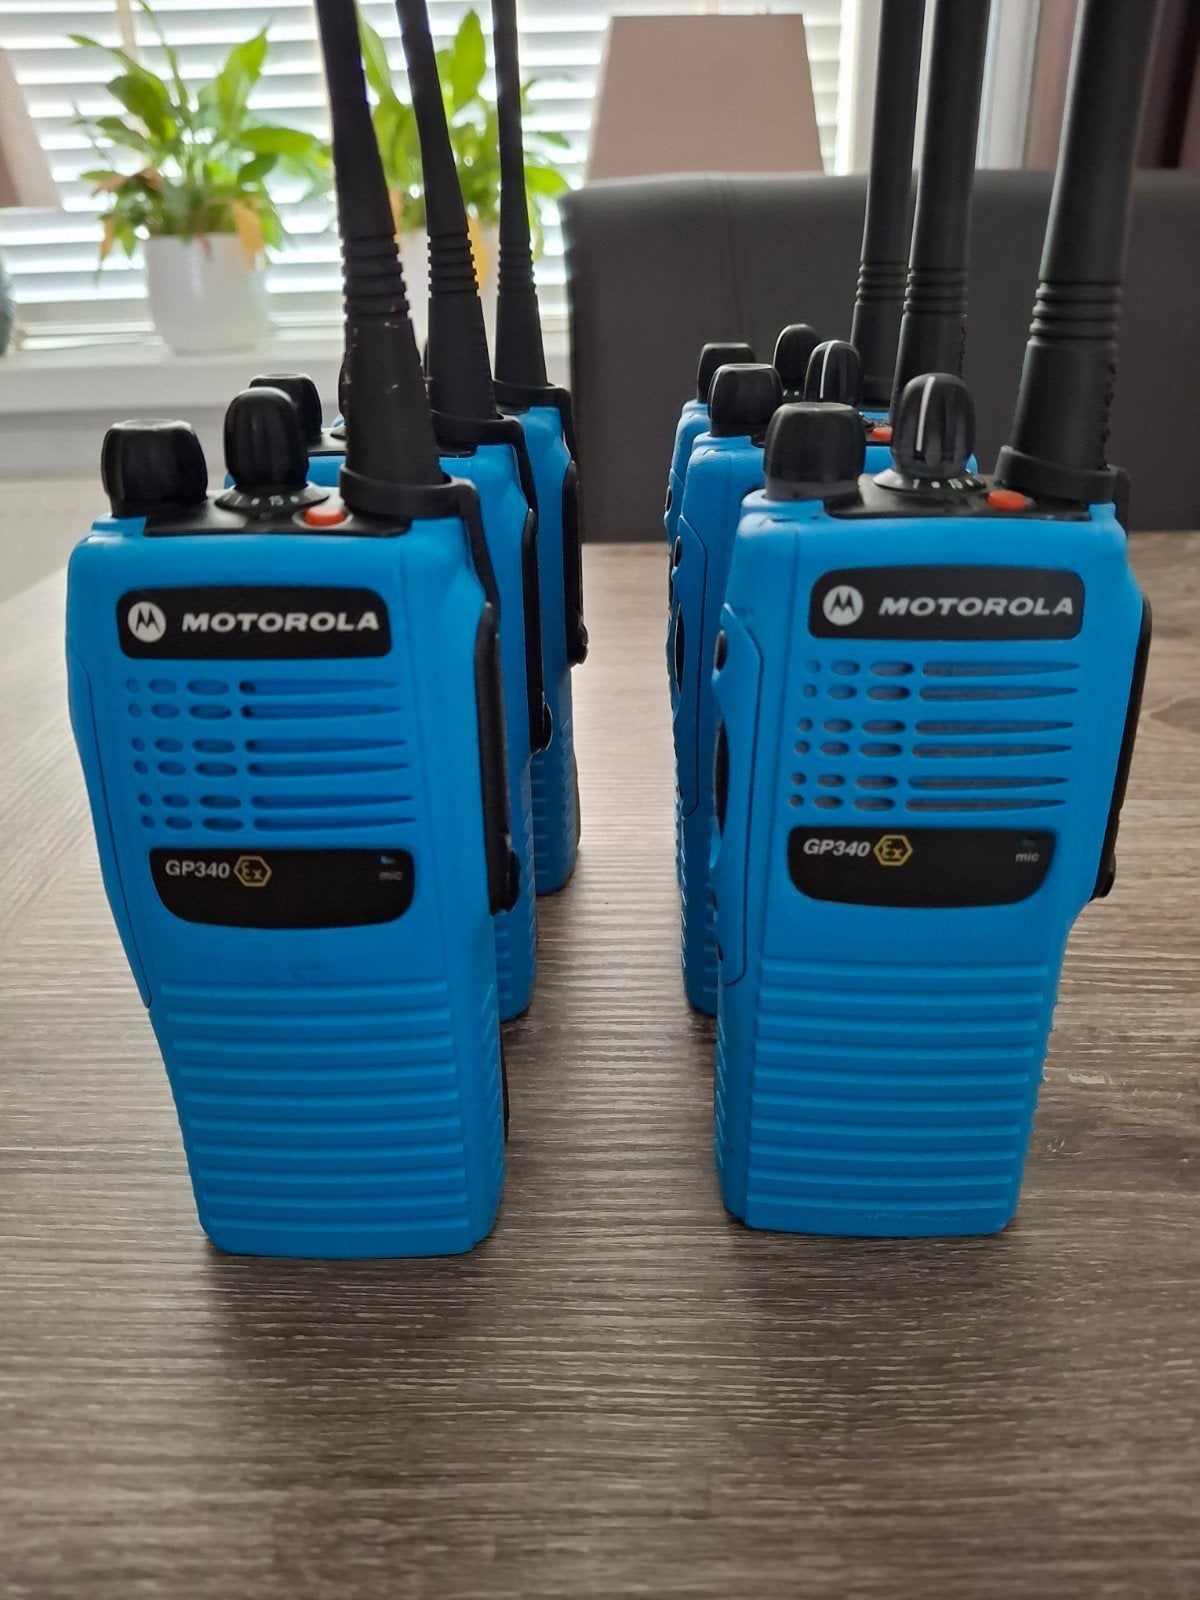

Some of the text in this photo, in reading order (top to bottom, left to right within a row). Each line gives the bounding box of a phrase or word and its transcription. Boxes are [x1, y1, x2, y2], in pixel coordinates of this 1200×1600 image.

[947, 478, 963, 489] 15
[878, 597, 1073, 617] MOTOROLA
[181, 611, 379, 633] MOTOROLA
[803, 838, 870, 857] GP340
[1015, 850, 1040, 863] mic
[165, 859, 231, 878] GP340
